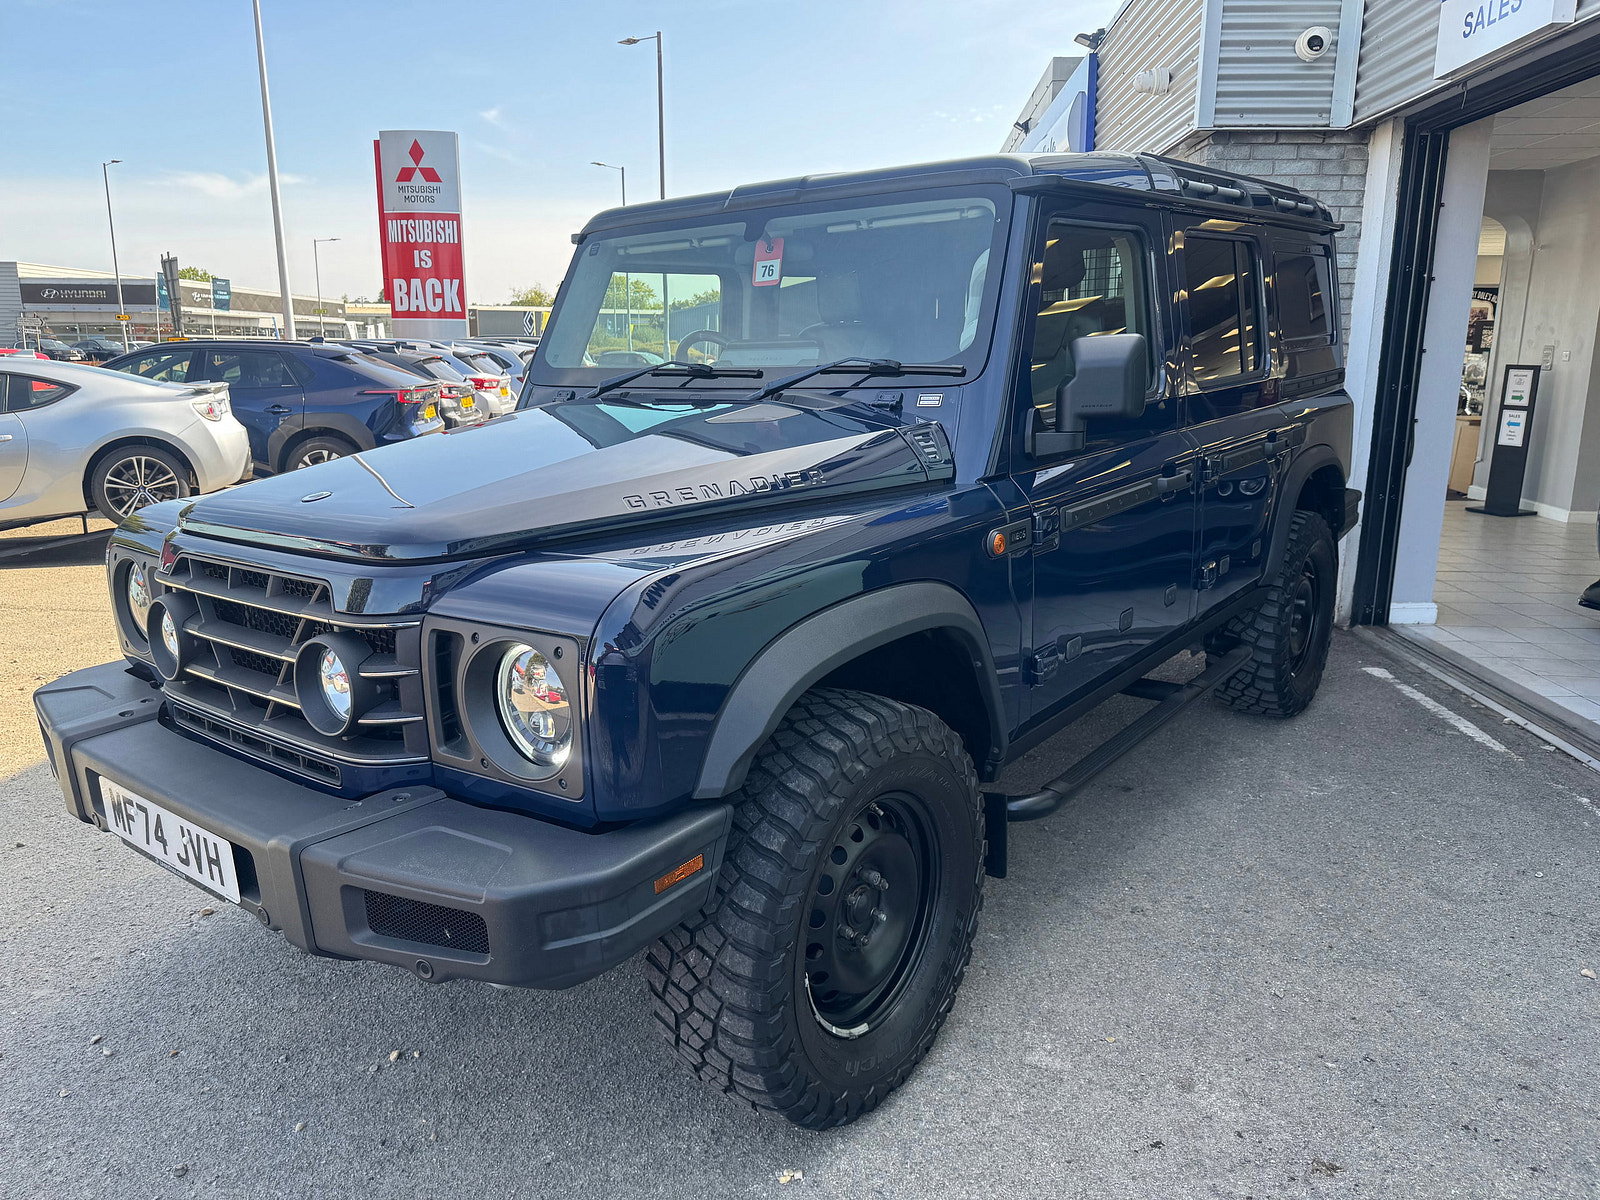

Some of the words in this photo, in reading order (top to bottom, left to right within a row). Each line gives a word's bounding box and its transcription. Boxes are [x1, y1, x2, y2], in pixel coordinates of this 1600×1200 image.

[1462, 0, 1523, 39] SALES
[397, 185, 441, 195] MITSUBISHI
[403, 194, 436, 204] MOTORS
[387, 219, 459, 244] MITSUBISHI
[413, 249, 433, 269] IS
[761, 264, 775, 278] 76
[60, 289, 107, 299] HYUNDAI
[392, 278, 462, 313] BACK
[622, 467, 827, 511] GRENADIER
[108, 787, 169, 856] MF74
[176, 825, 226, 887] JVH
